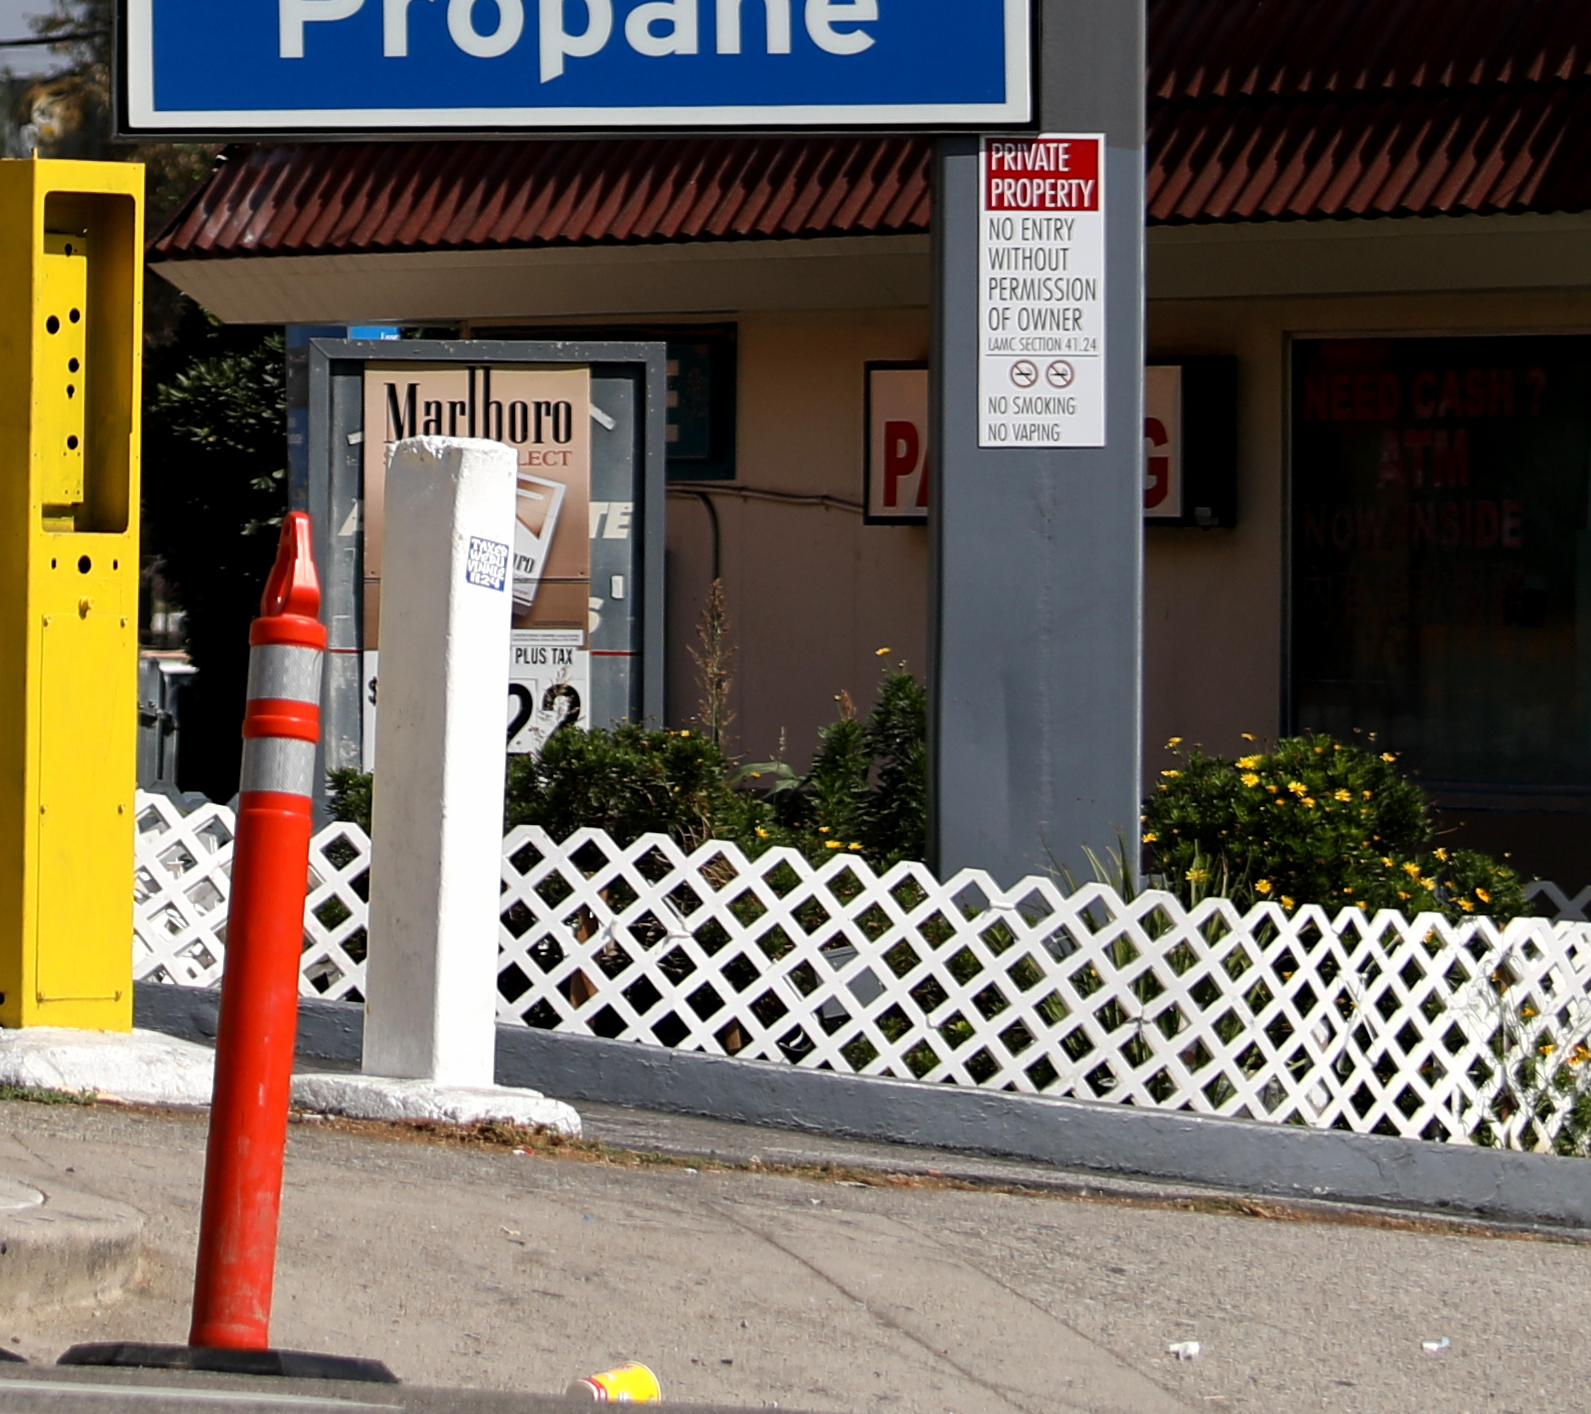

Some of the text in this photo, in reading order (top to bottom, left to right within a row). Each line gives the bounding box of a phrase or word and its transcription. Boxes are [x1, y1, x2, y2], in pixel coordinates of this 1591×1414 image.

[991, 142, 1070, 172] PRIVATE
[990, 177, 1096, 209] PROPERTY
[988, 217, 1075, 242] NO ENTRY
[988, 247, 1069, 272] WITHOUT
[988, 277, 1097, 302] PERMISSION
[988, 307, 1083, 332] OF OWNER
[988, 336, 1097, 353] LAMC SECTION 41.24
[383, 365, 573, 446] Marlboro
[988, 395, 1076, 416] NO SMOKING
[988, 423, 1061, 443] NO VAPING
[518, 450, 573, 467] LECT
[515, 647, 573, 665] PLUS TAX
